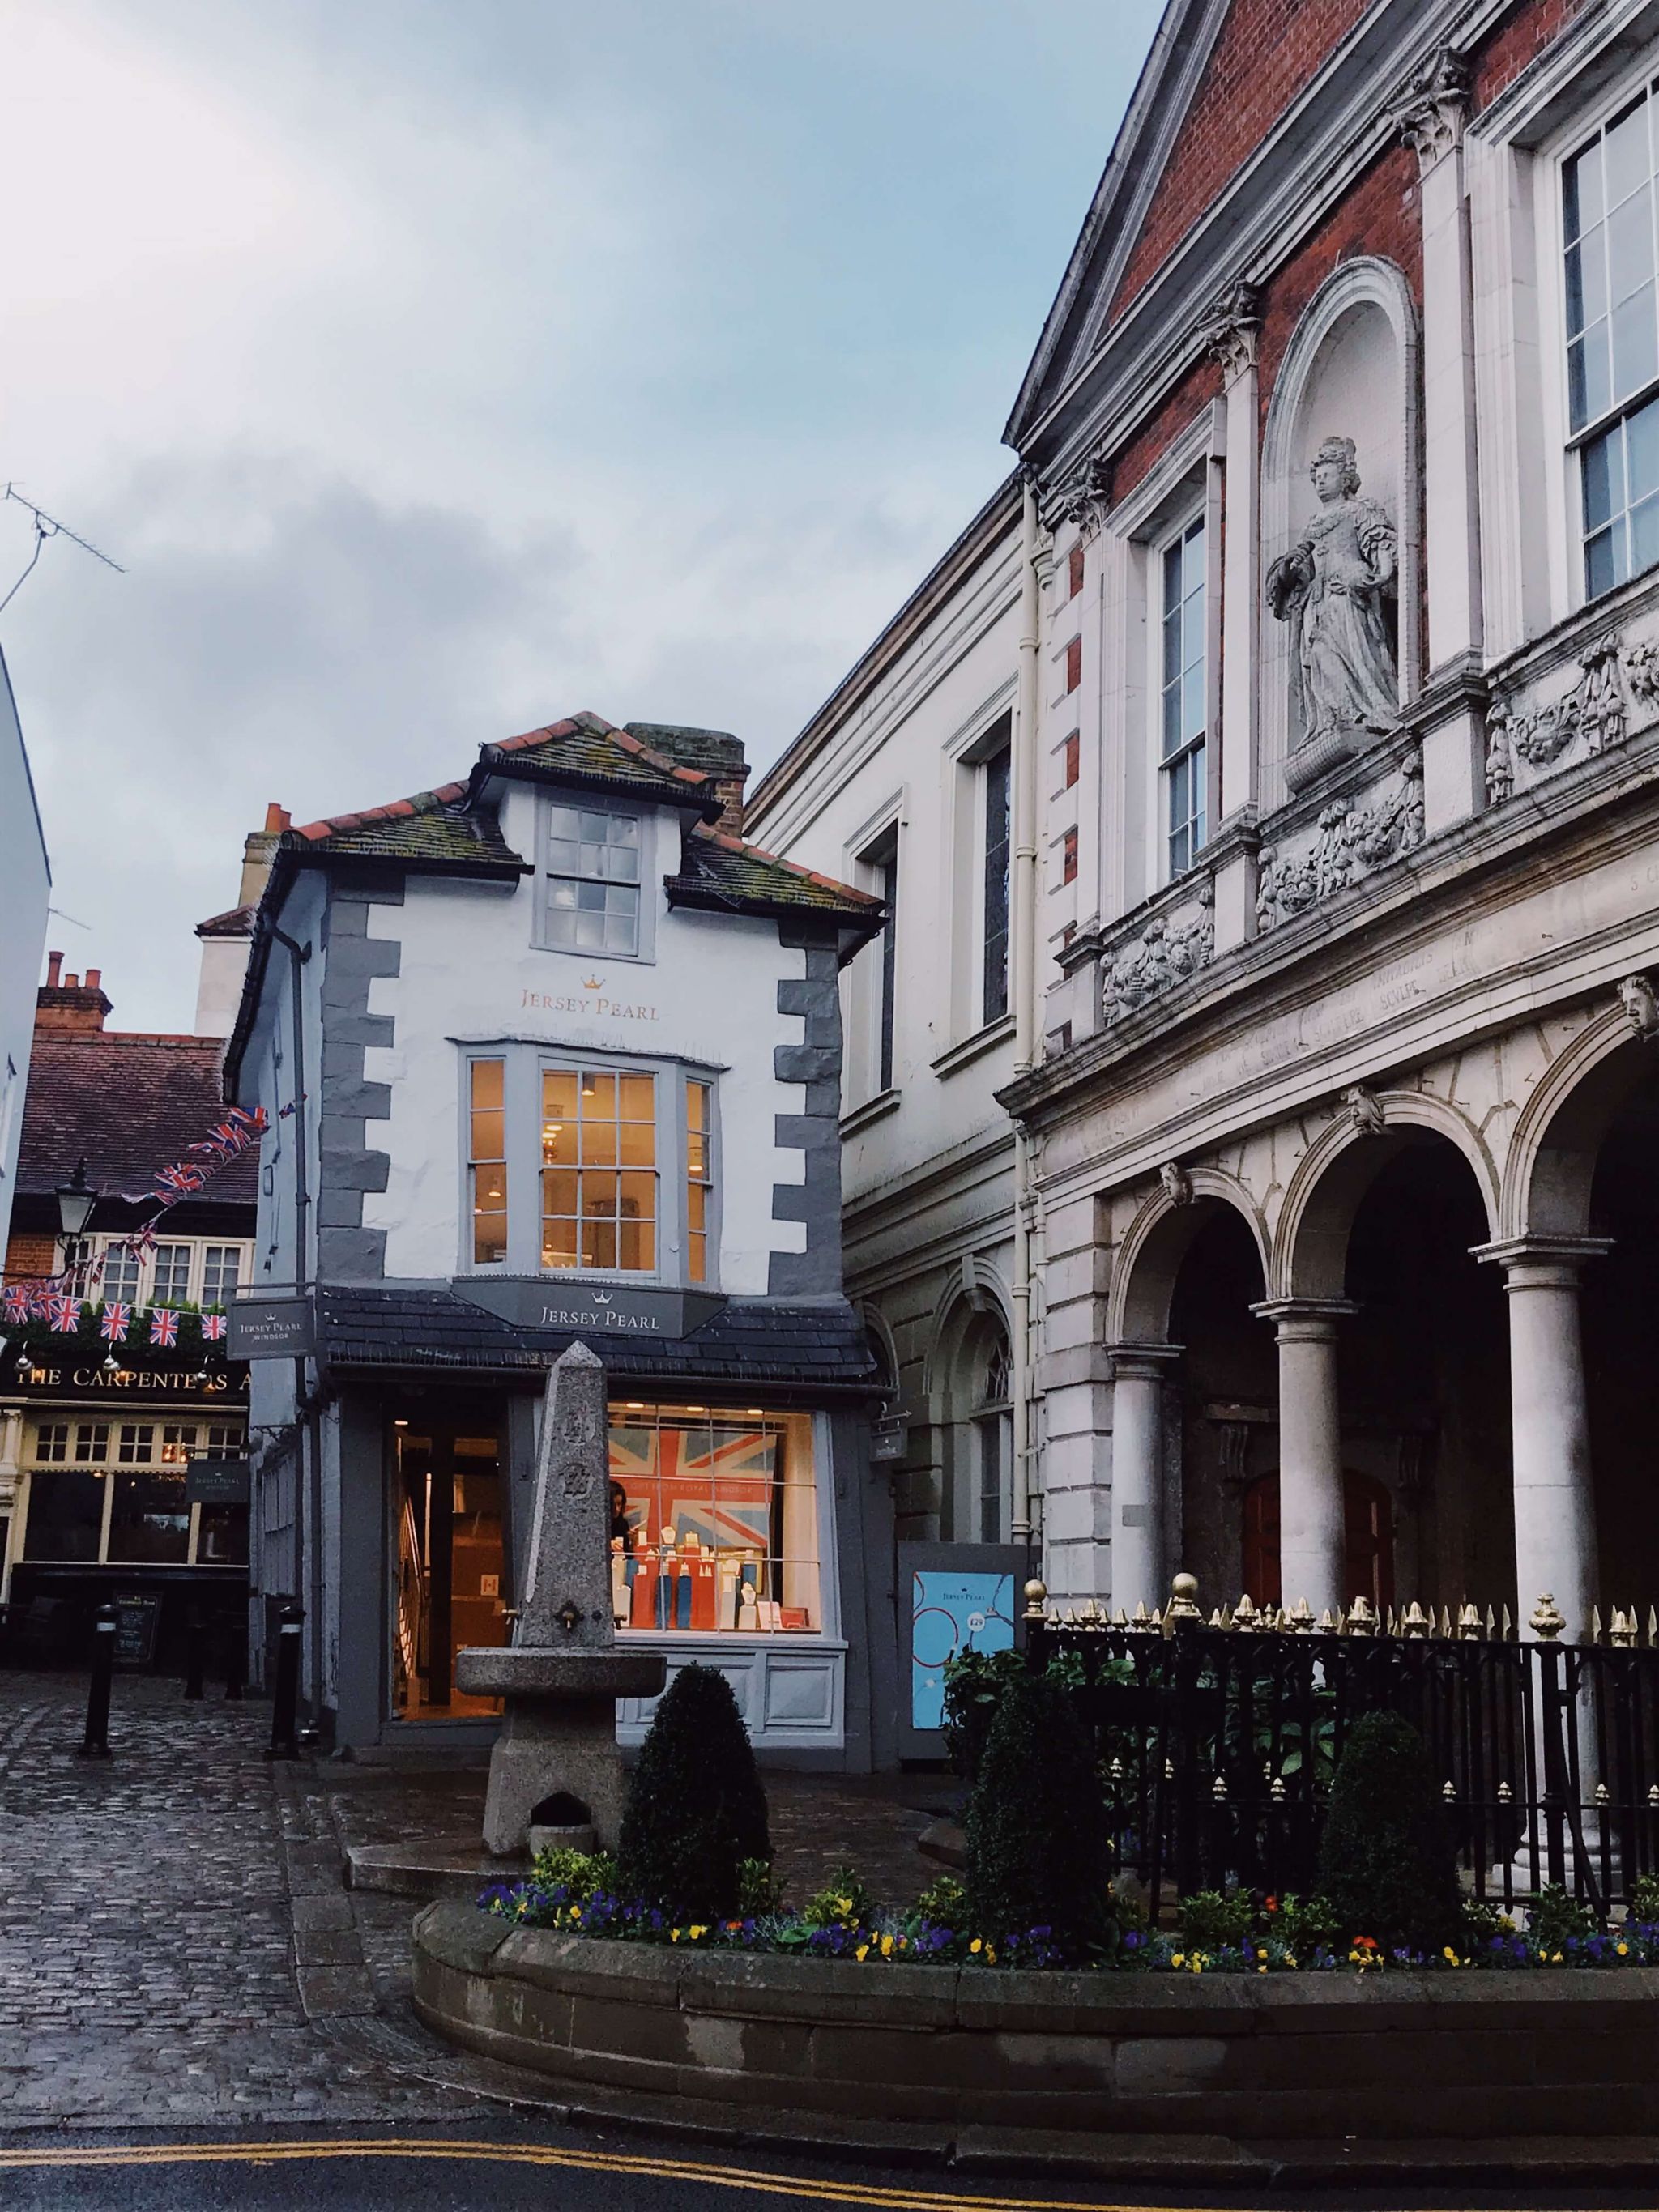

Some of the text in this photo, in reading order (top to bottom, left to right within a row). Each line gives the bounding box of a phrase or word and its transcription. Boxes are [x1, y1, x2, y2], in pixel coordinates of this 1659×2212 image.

[521, 989, 660, 1021] JERSEY PEARL
[540, 1306, 660, 1330] JERSEY PEARL
[241, 1323, 301, 1334] JERSEY PEARL
[17, 1368, 62, 1385] THE
